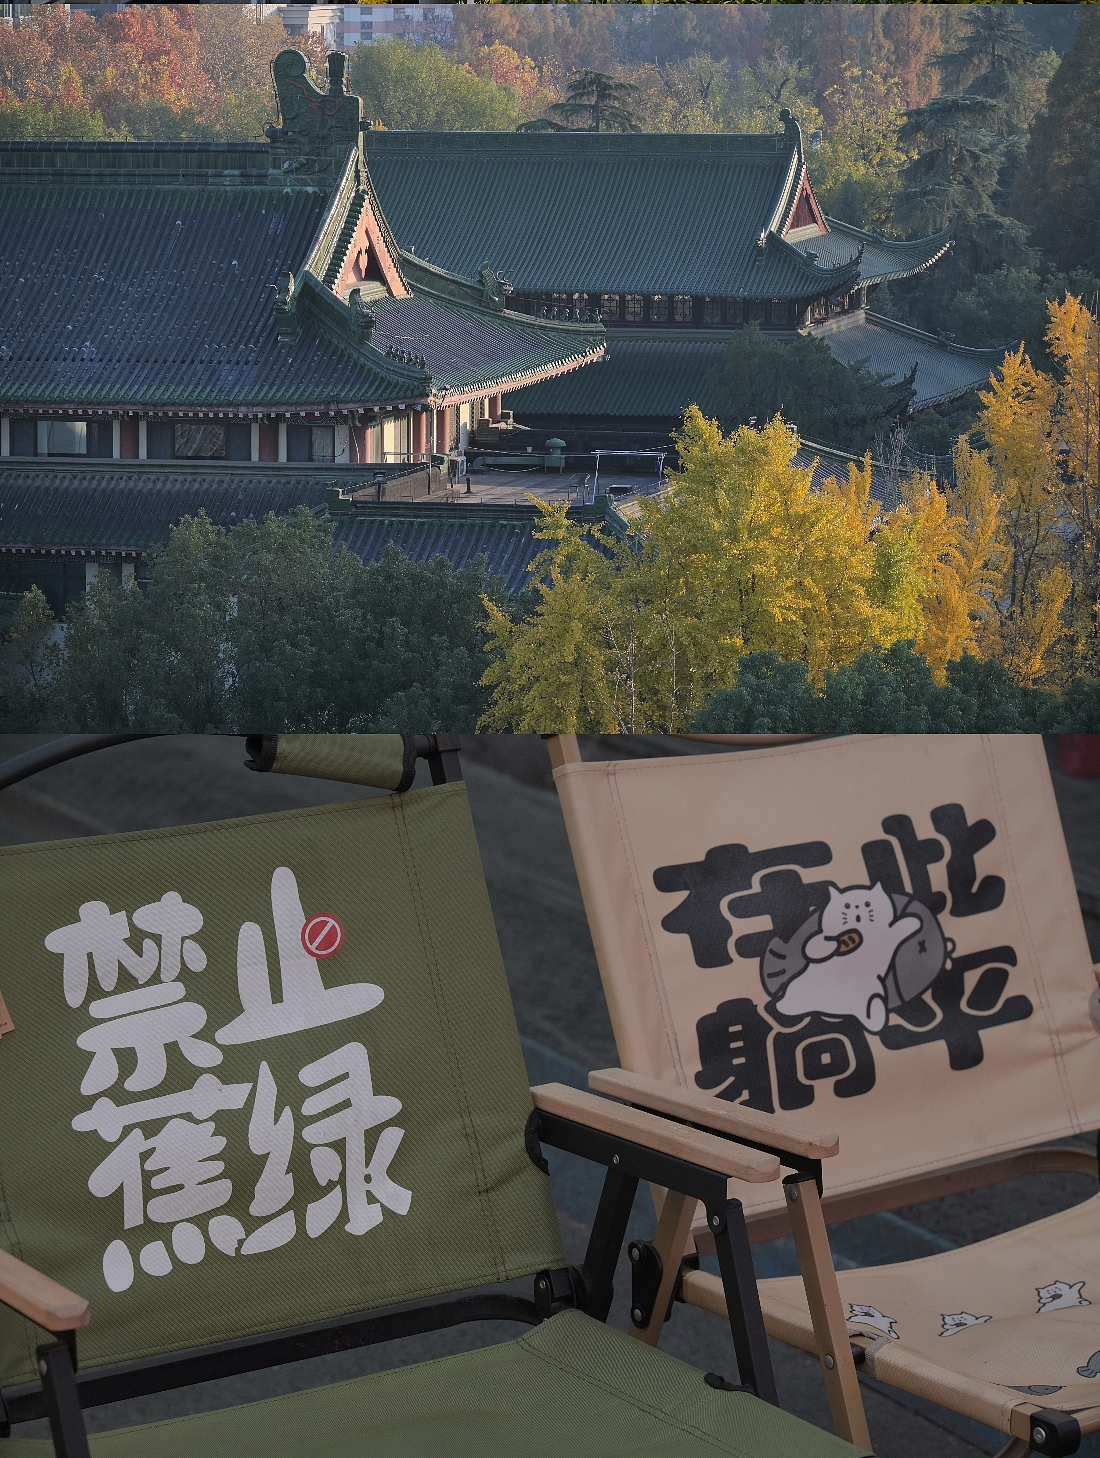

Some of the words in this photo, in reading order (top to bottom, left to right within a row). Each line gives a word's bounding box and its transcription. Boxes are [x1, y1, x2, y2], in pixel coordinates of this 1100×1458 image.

[44, 866, 385, 1096] 禁止
[652, 803, 1006, 969] 在此
[694, 945, 1034, 1115] 躺平
[71, 1041, 413, 1293] 蕉绿
